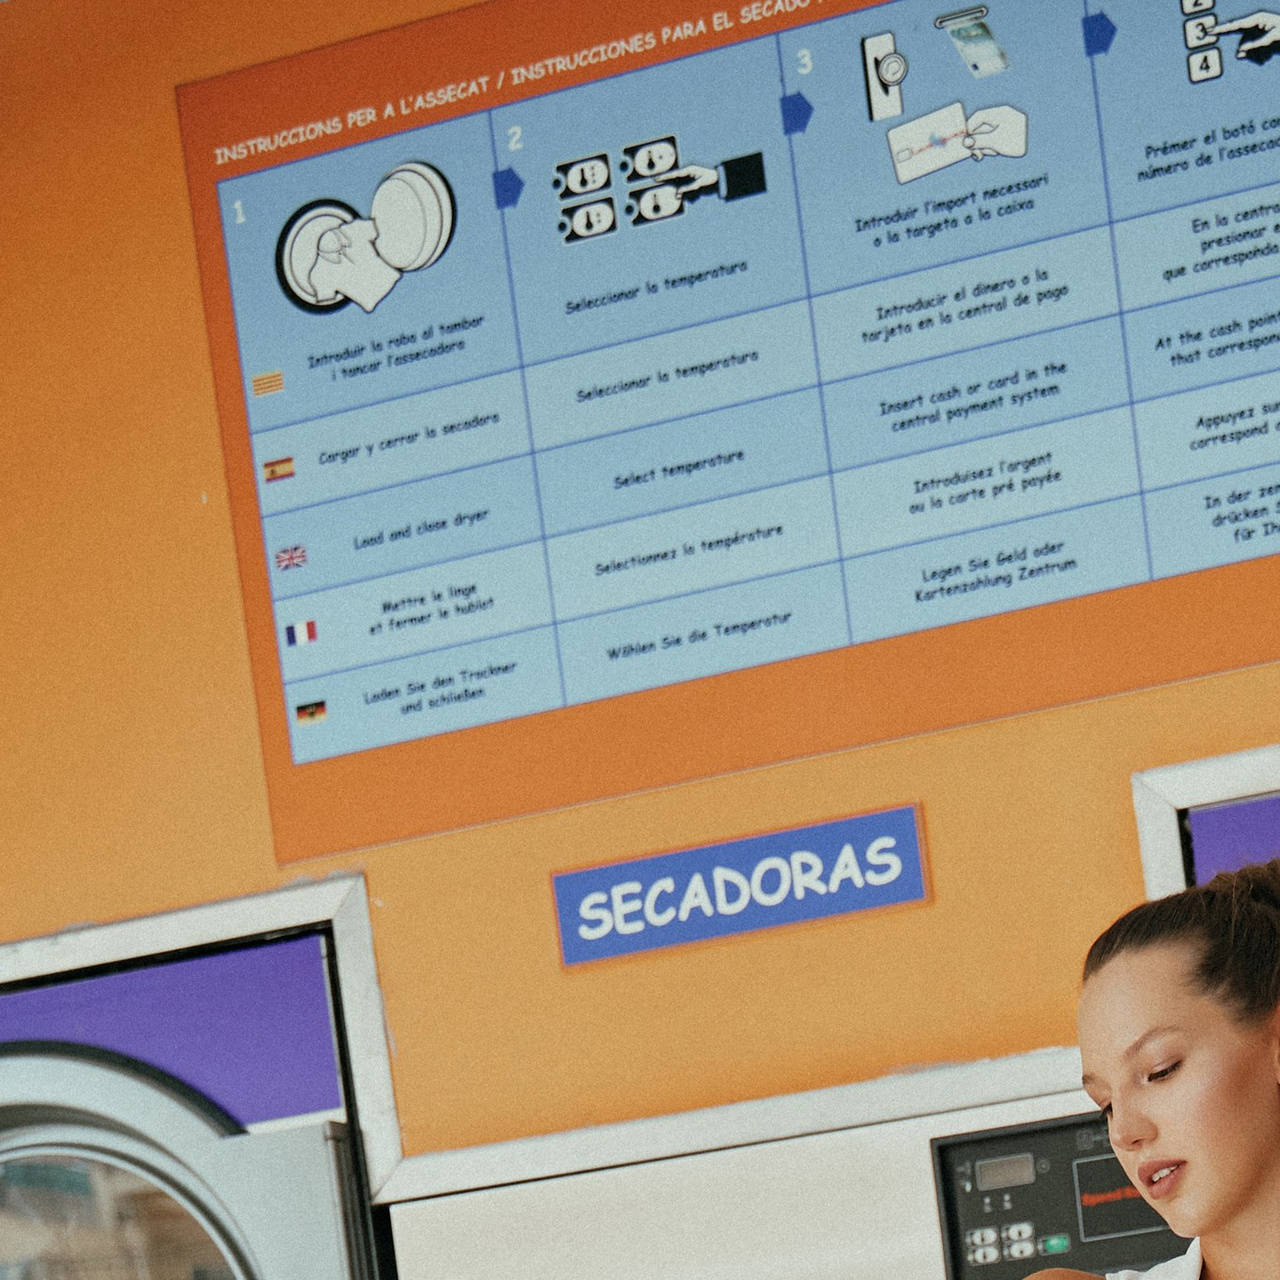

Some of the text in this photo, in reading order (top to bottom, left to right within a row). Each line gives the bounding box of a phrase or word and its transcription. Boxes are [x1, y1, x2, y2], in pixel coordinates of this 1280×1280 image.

[797, 48, 814, 75] 3
[1199, 54, 1211, 73] 4
[214, 115, 343, 166] INSTRUCCIONS
[346, 106, 377, 128] PER
[399, 75, 490, 116] L'ASSECAT
[510, 31, 658, 86] INSTRUCCIONES
[660, 18, 707, 44] PARA
[711, 10, 735, 32] EL
[508, 125, 524, 151] 2
[1144, 137, 1198, 160] Prémer
[1202, 128, 1218, 146] el
[1220, 118, 1257, 142] botó
[1136, 159, 1190, 183] número
[1194, 151, 1214, 168] de
[232, 199, 246, 225] 1
[853, 206, 920, 234] Introduir
[923, 190, 978, 215] l'import
[885, 198, 1036, 245] la targeta la caixa
[1190, 217, 1211, 235] En
[1214, 213, 1230, 228] la
[1199, 225, 1268, 255] presionar
[1161, 265, 1188, 283] que
[1192, 241, 1280, 274] corresponda
[875, 268, 1050, 322] Introducir el dinero la
[860, 284, 1070, 344] tarjeta en la central de pago
[1154, 335, 1173, 352] At
[1177, 330, 1204, 345] the
[1208, 319, 1243, 340] cash
[1169, 348, 1202, 367] that
[878, 361, 1068, 417] Insert cash or card in the
[890, 383, 1061, 433] central payment system
[1195, 406, 1256, 431] Appuyez
[1188, 420, 1270, 452] correspond
[912, 450, 1053, 495] Introduisez l'argent
[1203, 494, 1223, 511] In
[1225, 489, 1253, 506] der
[1210, 506, 1269, 529] drücken
[1232, 527, 1257, 543] für
[921, 541, 1066, 584] Legen Sie Geld oder
[913, 558, 1078, 603] Kartenzahlung Zentrum
[578, 836, 903, 941] SECADORAS
